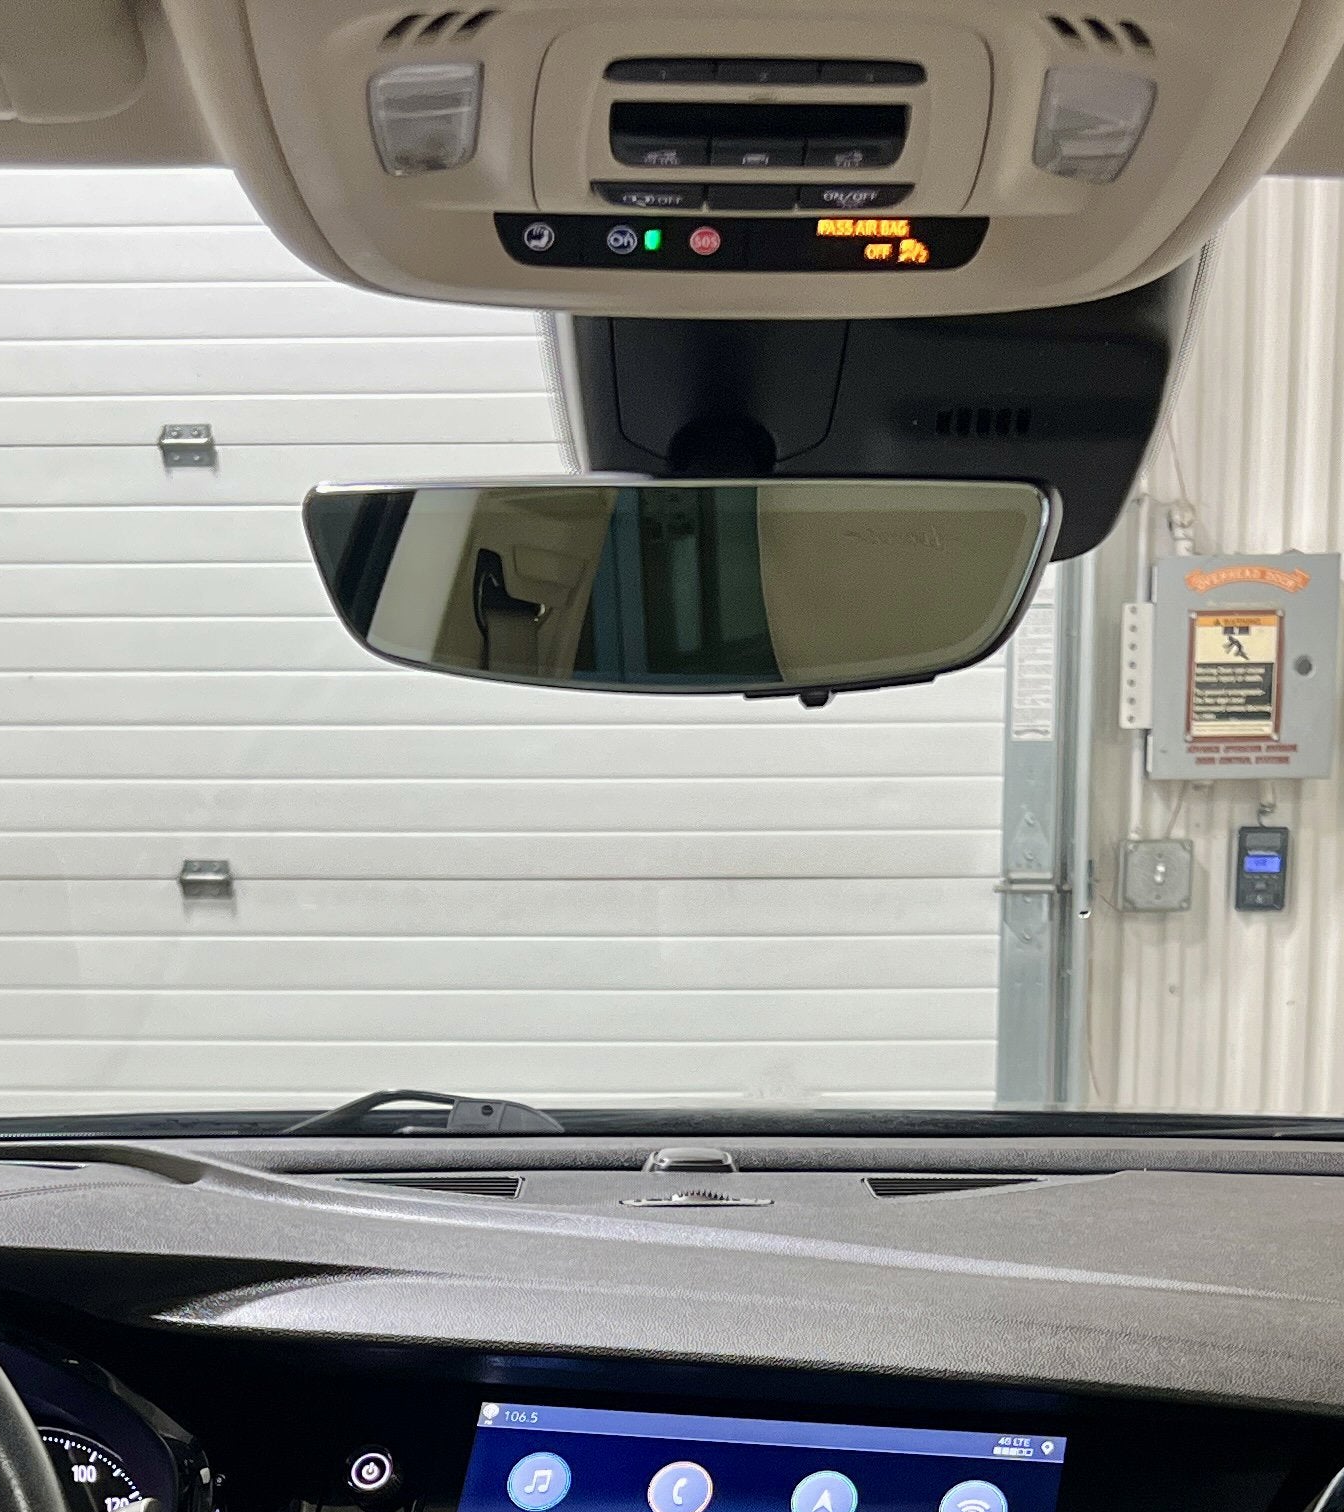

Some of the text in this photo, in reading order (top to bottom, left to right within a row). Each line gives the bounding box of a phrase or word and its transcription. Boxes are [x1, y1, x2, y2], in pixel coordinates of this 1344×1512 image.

[817, 219, 910, 237] PASS AIR BAG
[864, 243, 893, 260] OFF
[504, 1410, 539, 1423] 106.5
[1012, 1438, 1032, 1448] LTE
[71, 1464, 97, 1483] 100
